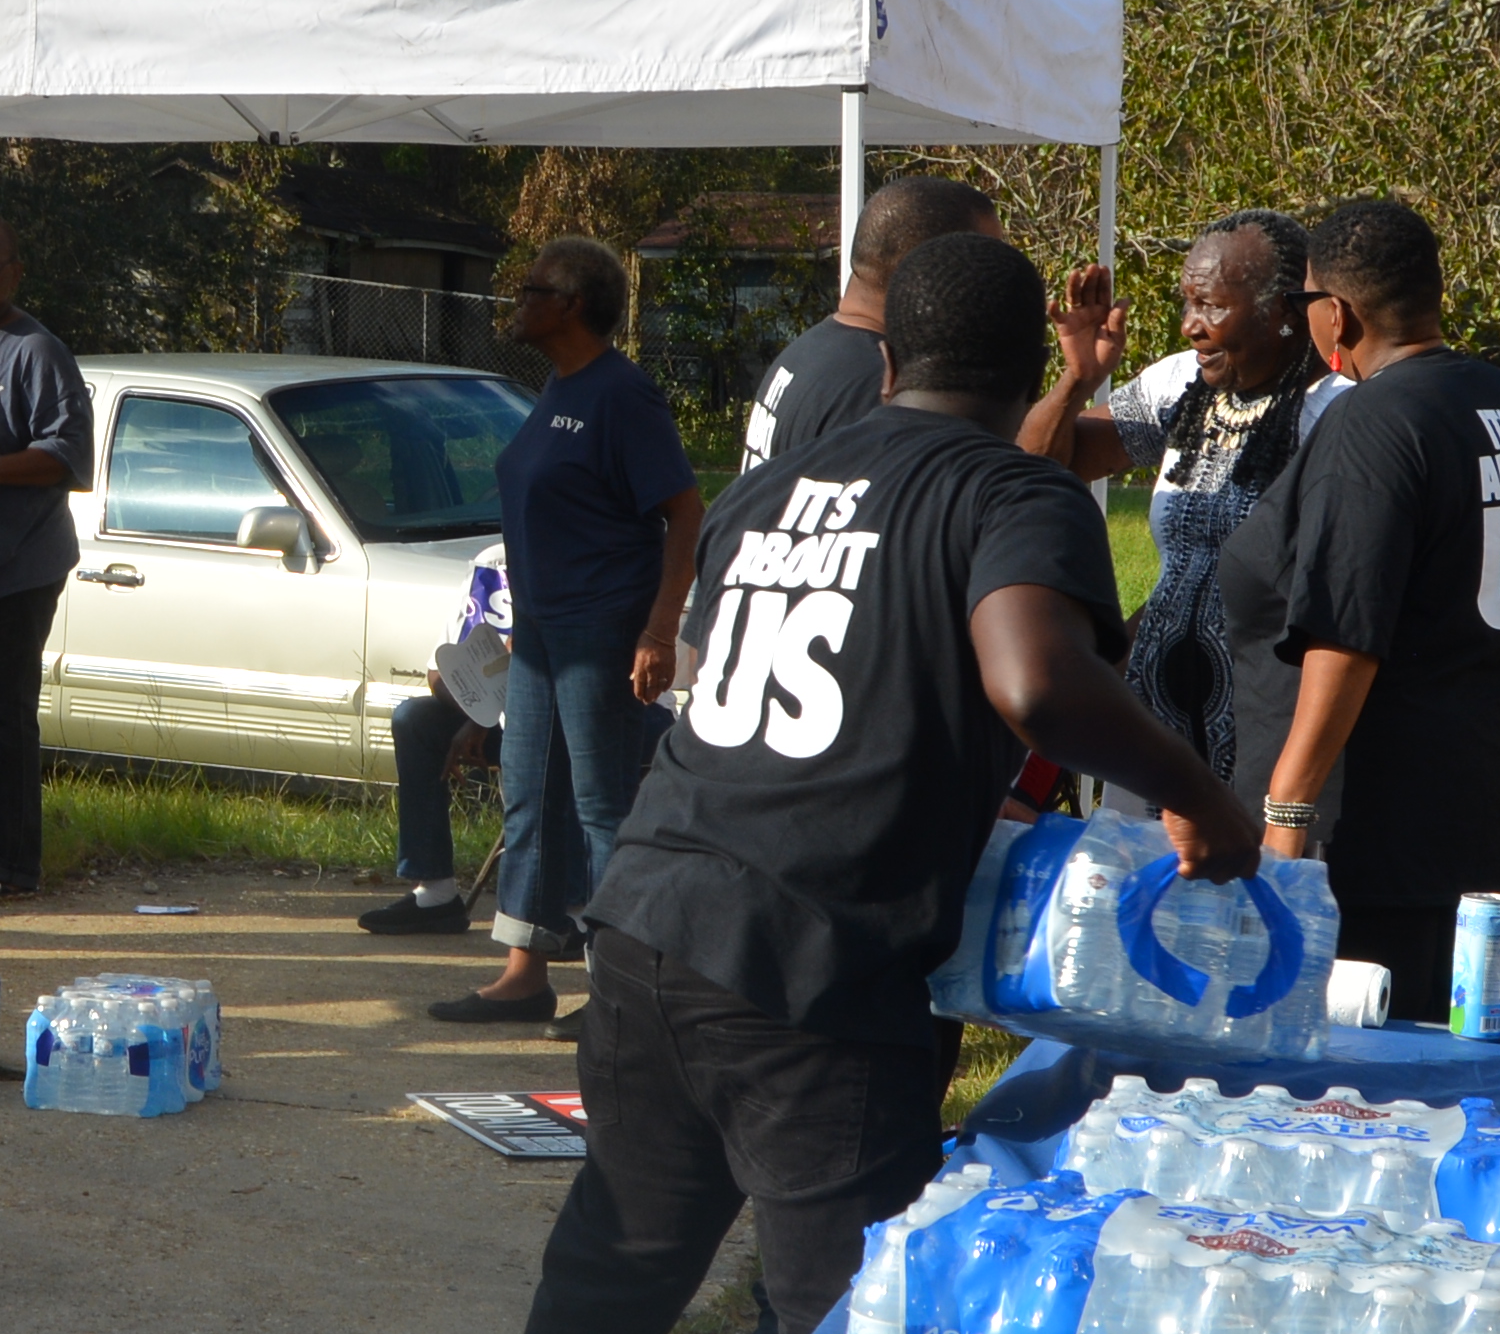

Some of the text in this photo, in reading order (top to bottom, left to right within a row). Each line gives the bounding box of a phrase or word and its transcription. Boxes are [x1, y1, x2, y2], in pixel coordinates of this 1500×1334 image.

[551, 415, 584, 434] RSVP
[779, 477, 872, 535] IT'S
[724, 531, 880, 591] ABOUT
[688, 589, 854, 758] US
[435, 1094, 572, 1134] TODAY!
[1249, 1116, 1431, 1143] WATER
[1156, 1203, 1368, 1238] WATER
